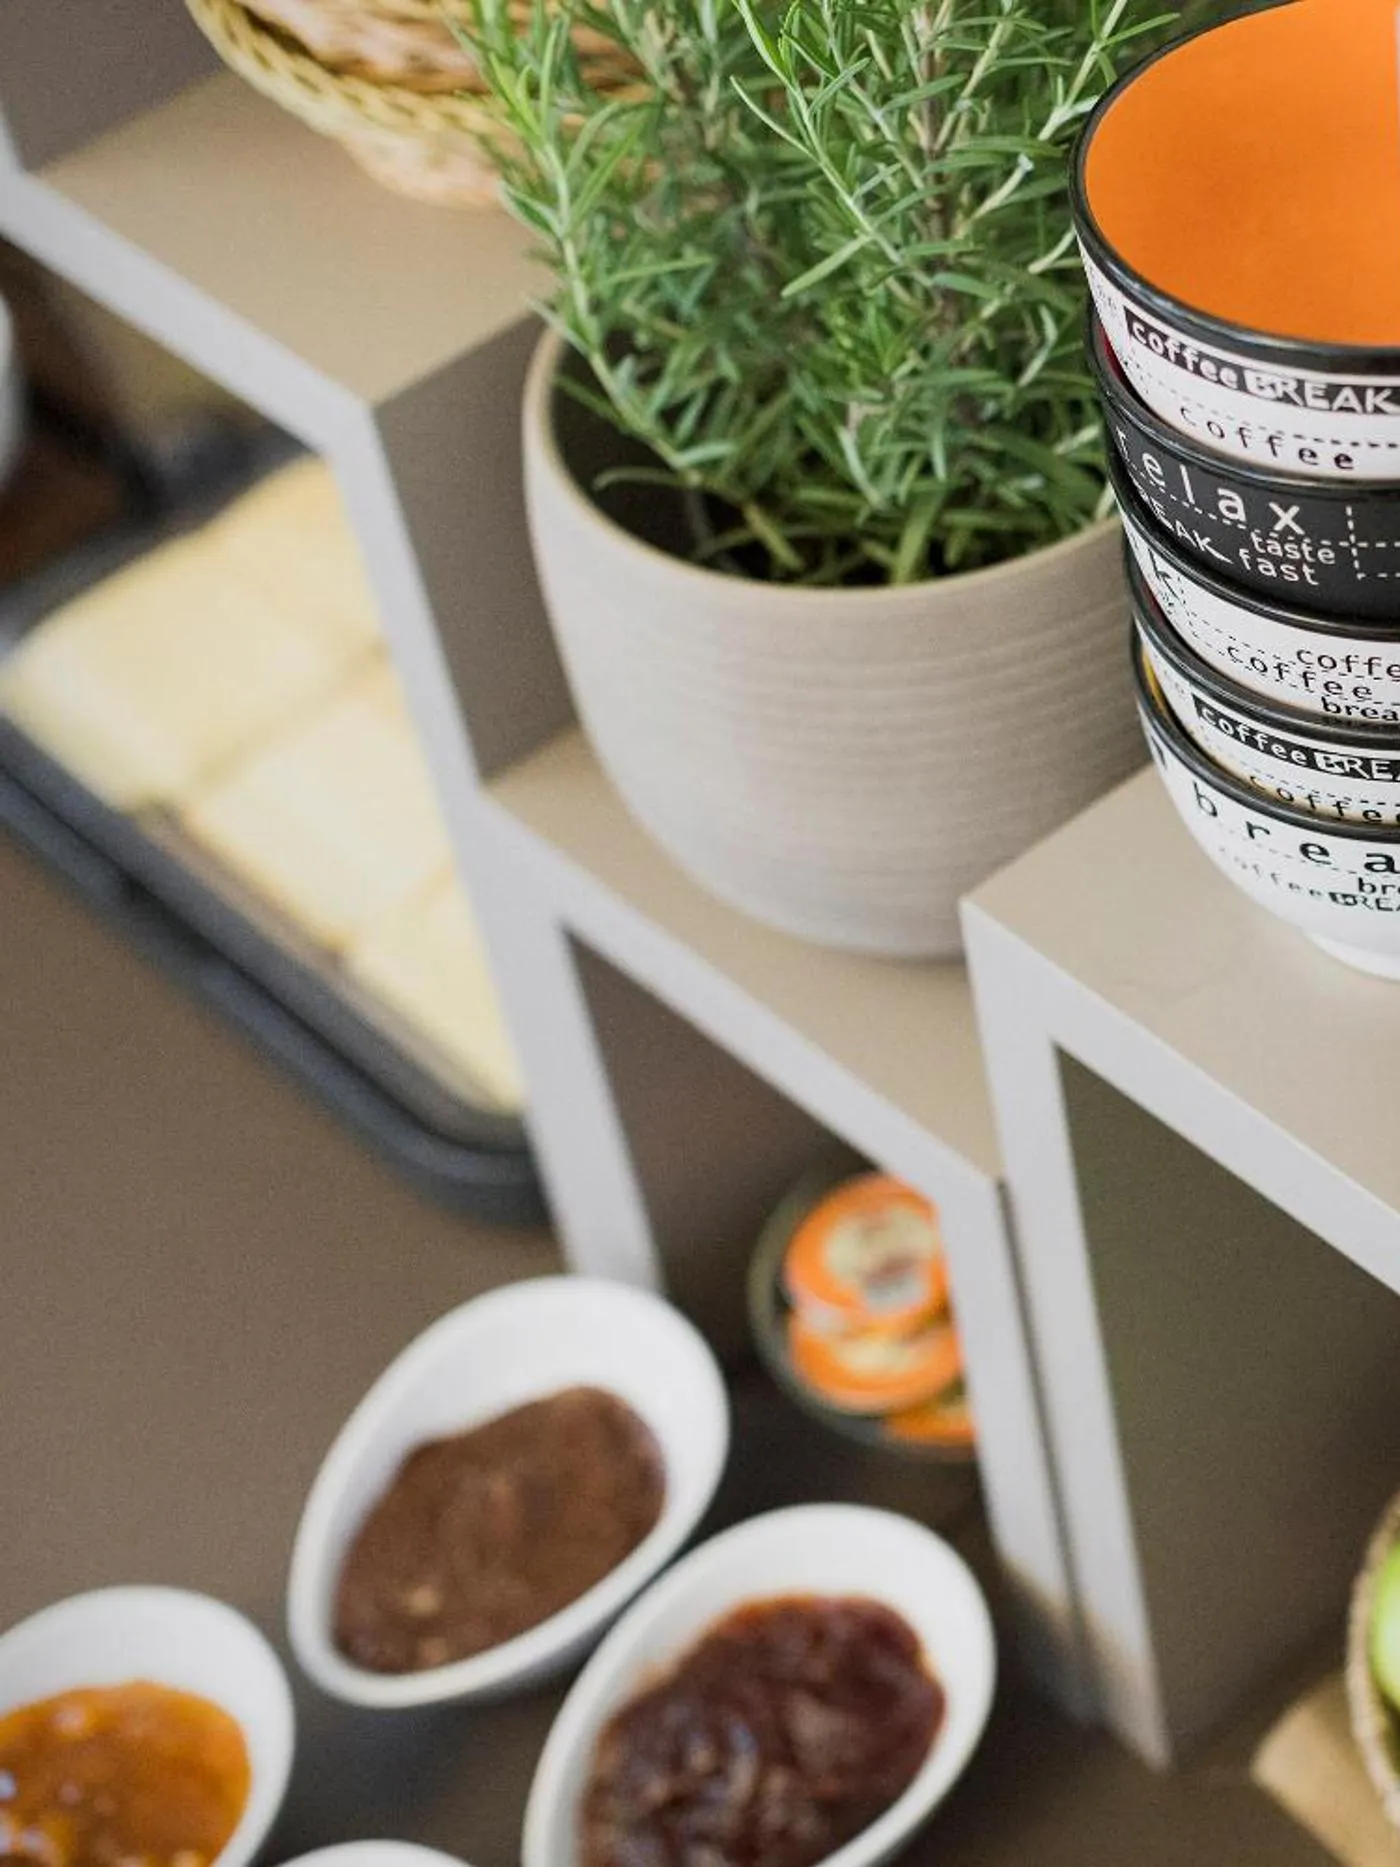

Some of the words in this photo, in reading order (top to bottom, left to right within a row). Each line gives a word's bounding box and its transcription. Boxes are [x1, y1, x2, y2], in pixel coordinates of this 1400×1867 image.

[1180, 406, 1354, 470] coffee
[1251, 529, 1336, 564] taste
[1227, 645, 1373, 700] coffee
